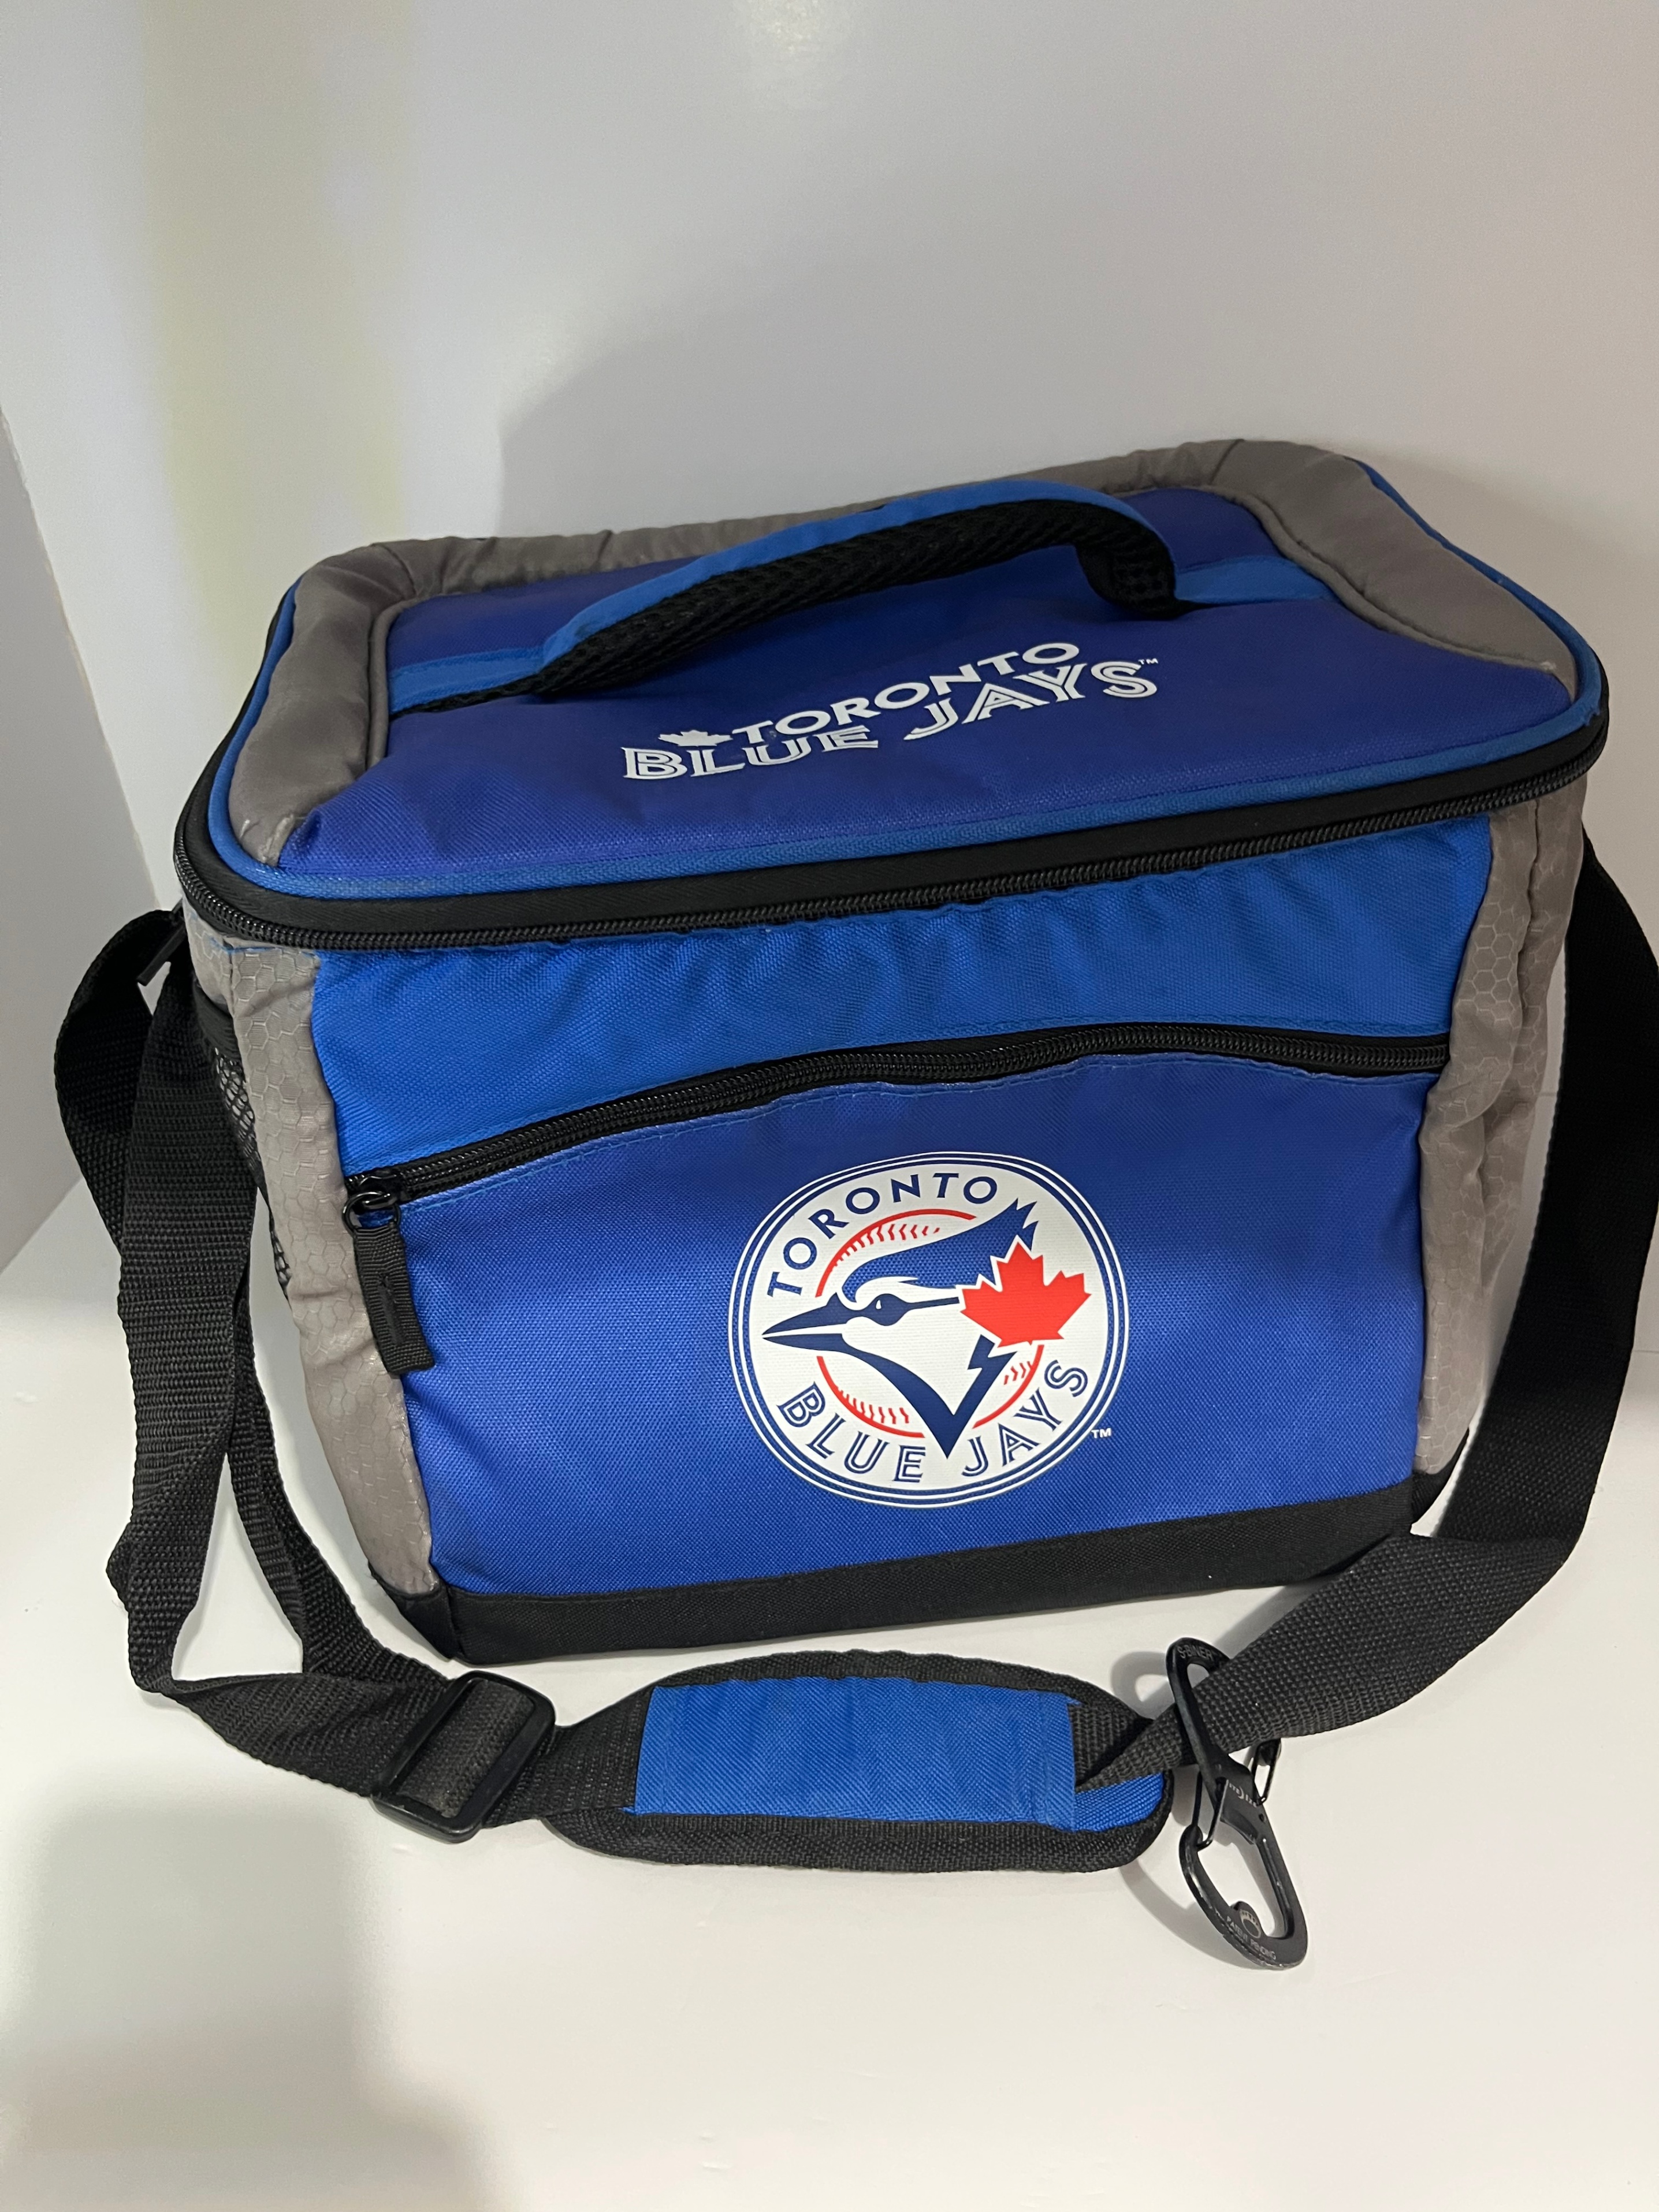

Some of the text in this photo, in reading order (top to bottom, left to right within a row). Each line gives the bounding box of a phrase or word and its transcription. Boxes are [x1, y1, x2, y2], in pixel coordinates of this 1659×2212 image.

[622, 724, 879, 780] BLUE
[904, 661, 1158, 740] JAYS
[732, 642, 1079, 744] TORONTO
[767, 1172, 998, 1298] TORONTO
[776, 1380, 927, 1483] BLUE
[961, 1359, 1088, 1477] JAYS
